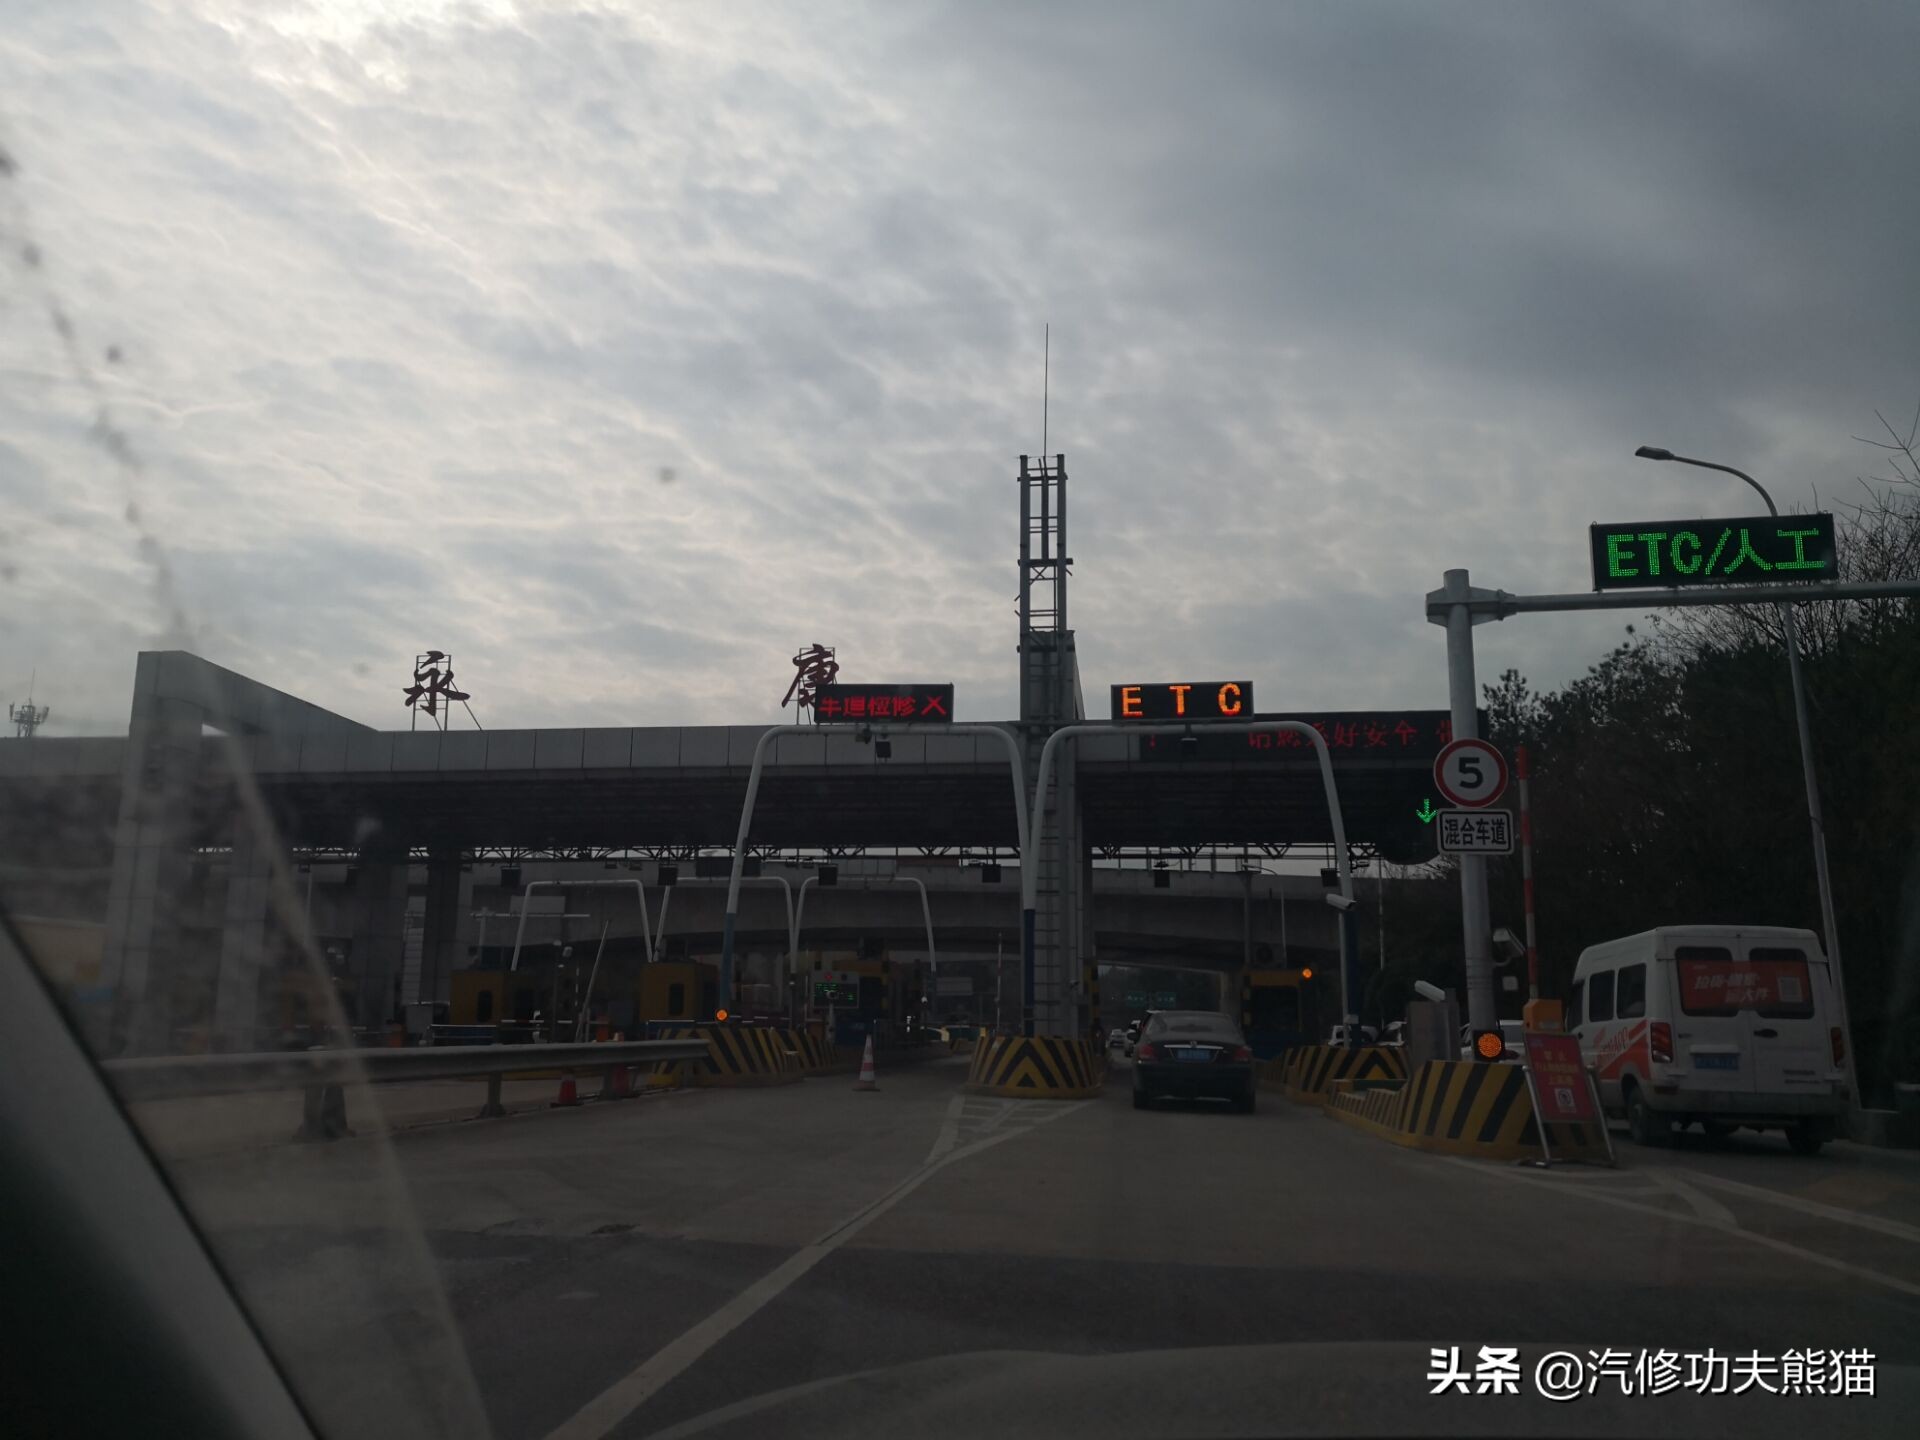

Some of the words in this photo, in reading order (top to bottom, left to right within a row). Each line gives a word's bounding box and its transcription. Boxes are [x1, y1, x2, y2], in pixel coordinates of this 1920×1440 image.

[1606, 527, 1826, 578] ETC/人工
[403, 651, 470, 716] 永
[1120, 684, 1243, 718] ETC
[1459, 757, 1483, 789] 5
[1445, 818, 1507, 845] 混合车道
